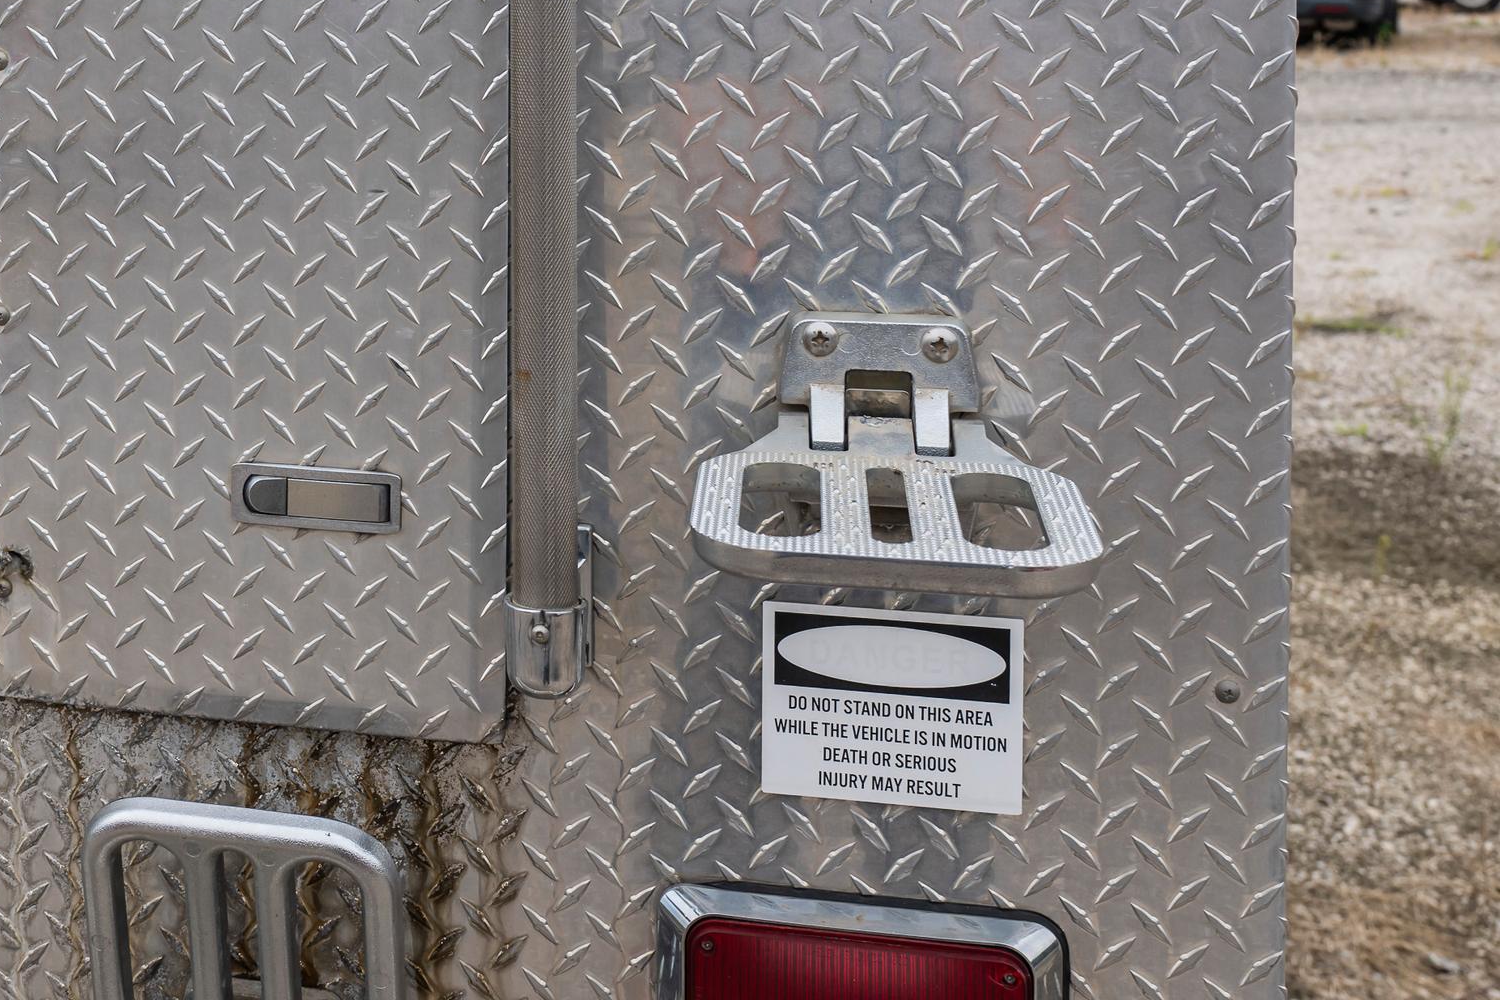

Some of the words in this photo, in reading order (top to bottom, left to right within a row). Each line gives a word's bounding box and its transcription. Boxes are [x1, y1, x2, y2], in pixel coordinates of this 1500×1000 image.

[808, 638, 970, 676] DANGER
[788, 694, 807, 712] DO
[811, 697, 840, 714] NOT
[843, 699, 891, 719] STAND
[895, 703, 915, 721] ON
[918, 705, 952, 723] THIS
[955, 708, 994, 727] AREA
[774, 718, 819, 737] WHILE
[822, 721, 848, 739] THE
[852, 724, 910, 745] VEHICLE
[914, 730, 928, 747] IS
[931, 731, 947, 748] IN
[950, 733, 1008, 753] MOTION
[822, 747, 868, 766] DEATH
[872, 750, 891, 768] OR
[895, 753, 957, 773] SERIOUS
[818, 770, 868, 790] INJURY
[871, 775, 903, 793] MAY
[906, 778, 961, 799] RESULT
